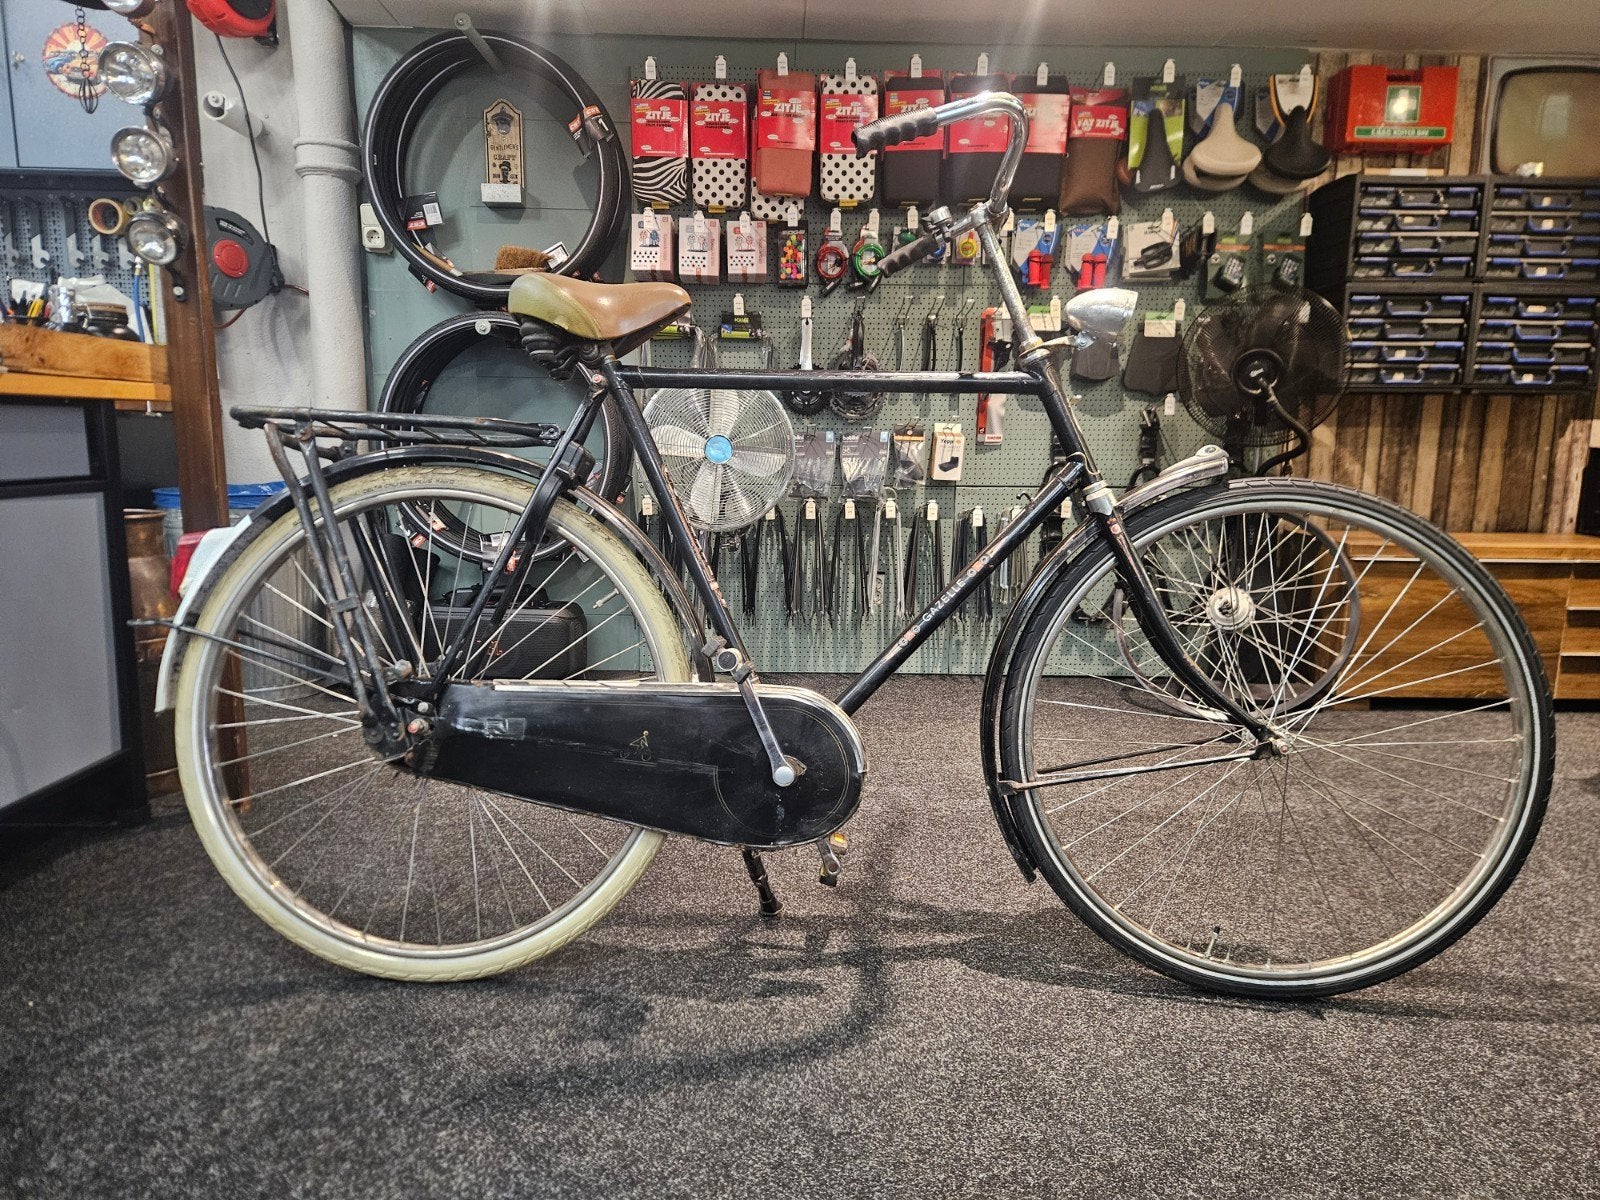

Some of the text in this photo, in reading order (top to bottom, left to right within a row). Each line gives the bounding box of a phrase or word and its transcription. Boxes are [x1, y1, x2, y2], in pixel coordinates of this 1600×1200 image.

[773, 103, 802, 113] ZITJE
[835, 106, 863, 116] ZITJE
[645, 110, 672, 120] ZITJE
[704, 113, 731, 122] ZITJE
[922, 578, 966, 622] GAZELLE
